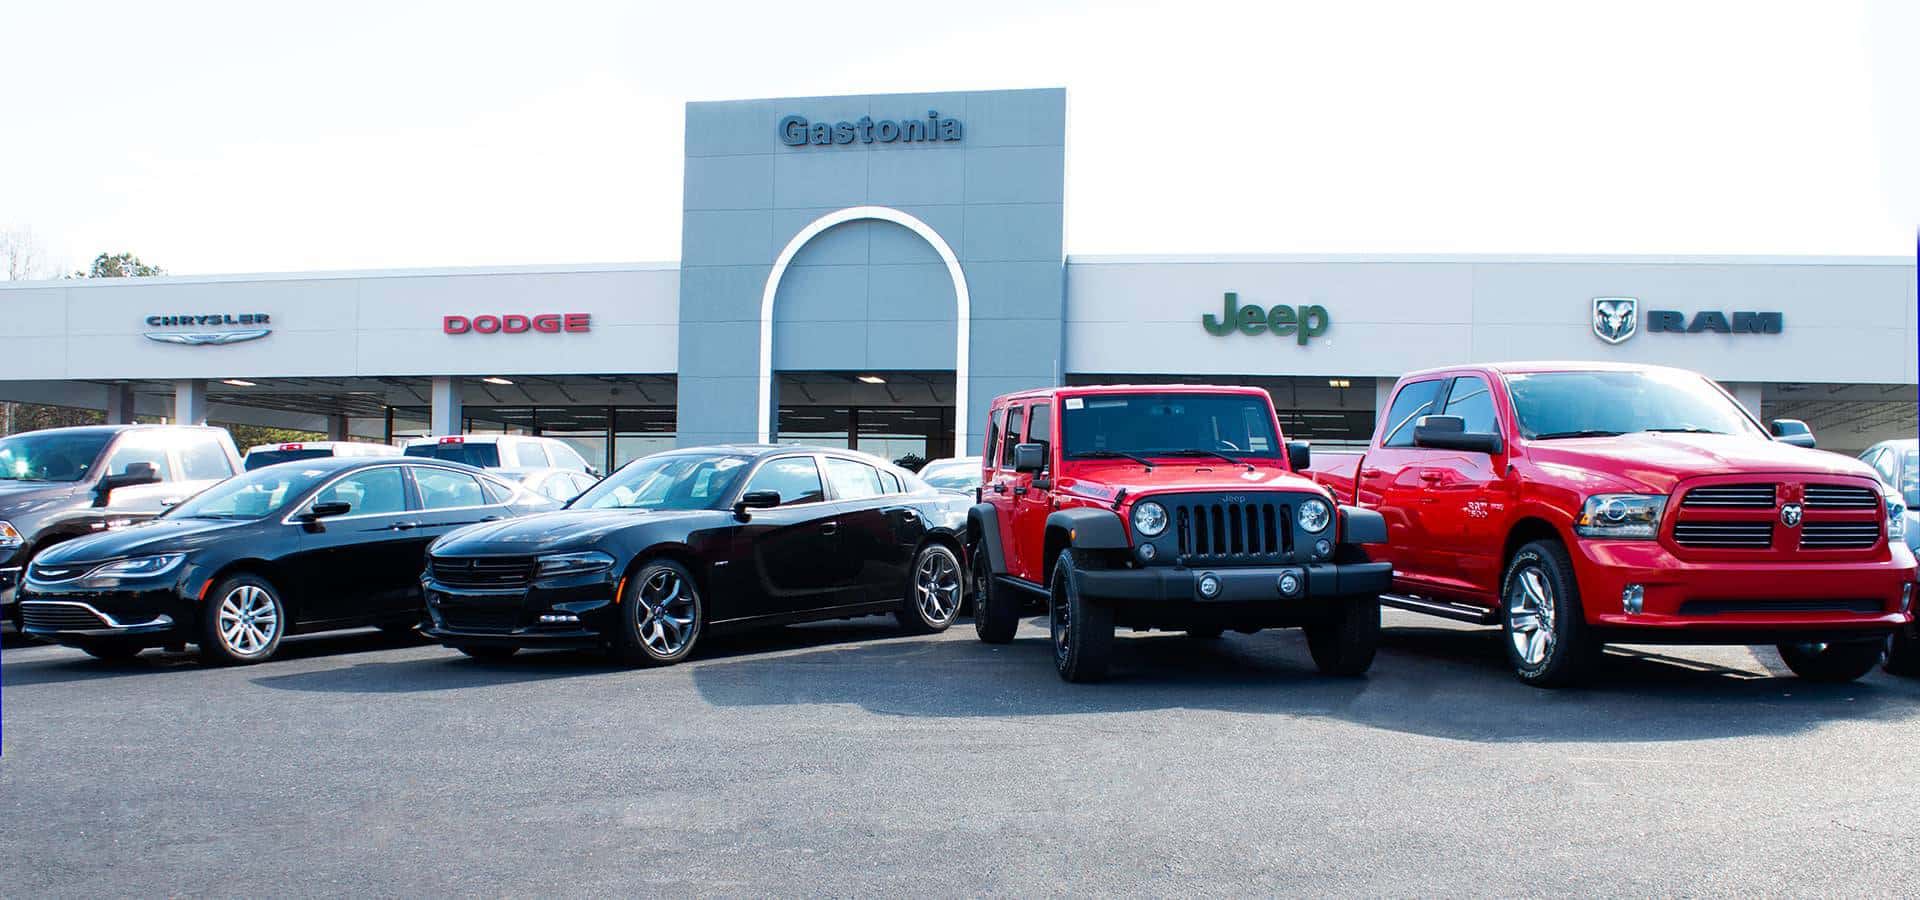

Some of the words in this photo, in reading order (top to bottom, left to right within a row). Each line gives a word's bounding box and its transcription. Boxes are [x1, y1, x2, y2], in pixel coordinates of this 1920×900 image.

[779, 110, 962, 146] Gastonia
[145, 313, 270, 326] CHRYSLER
[443, 313, 591, 334] DODGE
[1202, 292, 1329, 346] Jeep
[1647, 310, 1783, 333] RAM
